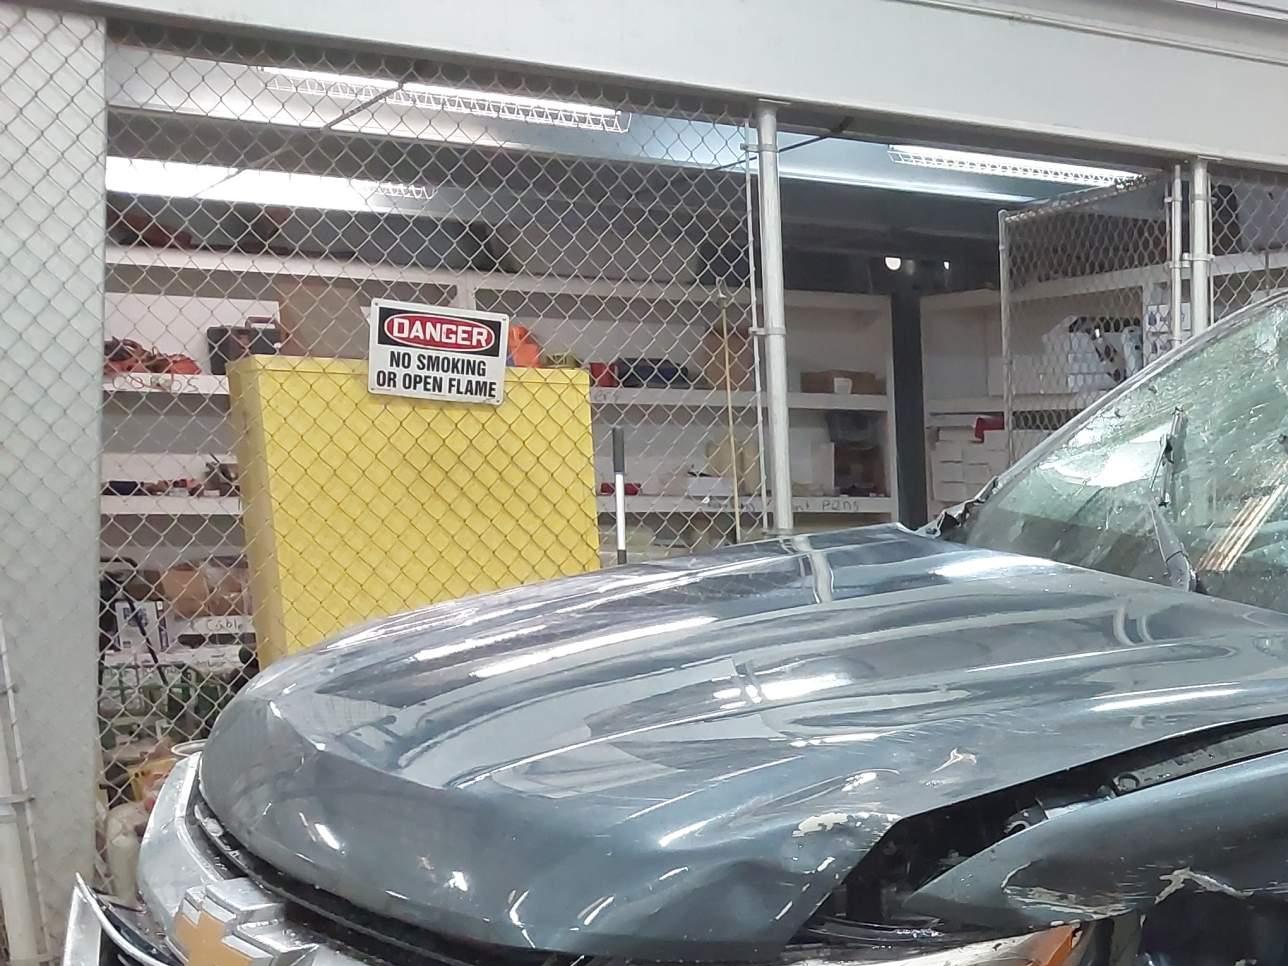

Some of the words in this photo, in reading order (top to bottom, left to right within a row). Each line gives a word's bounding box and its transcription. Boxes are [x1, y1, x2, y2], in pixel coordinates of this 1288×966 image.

[393, 318, 488, 346] DANGER
[390, 351, 411, 369] NO
[417, 354, 486, 376] SMOKING
[377, 371, 397, 388] OR
[402, 373, 443, 393] OPEN
[448, 378, 497, 398] FLAME
